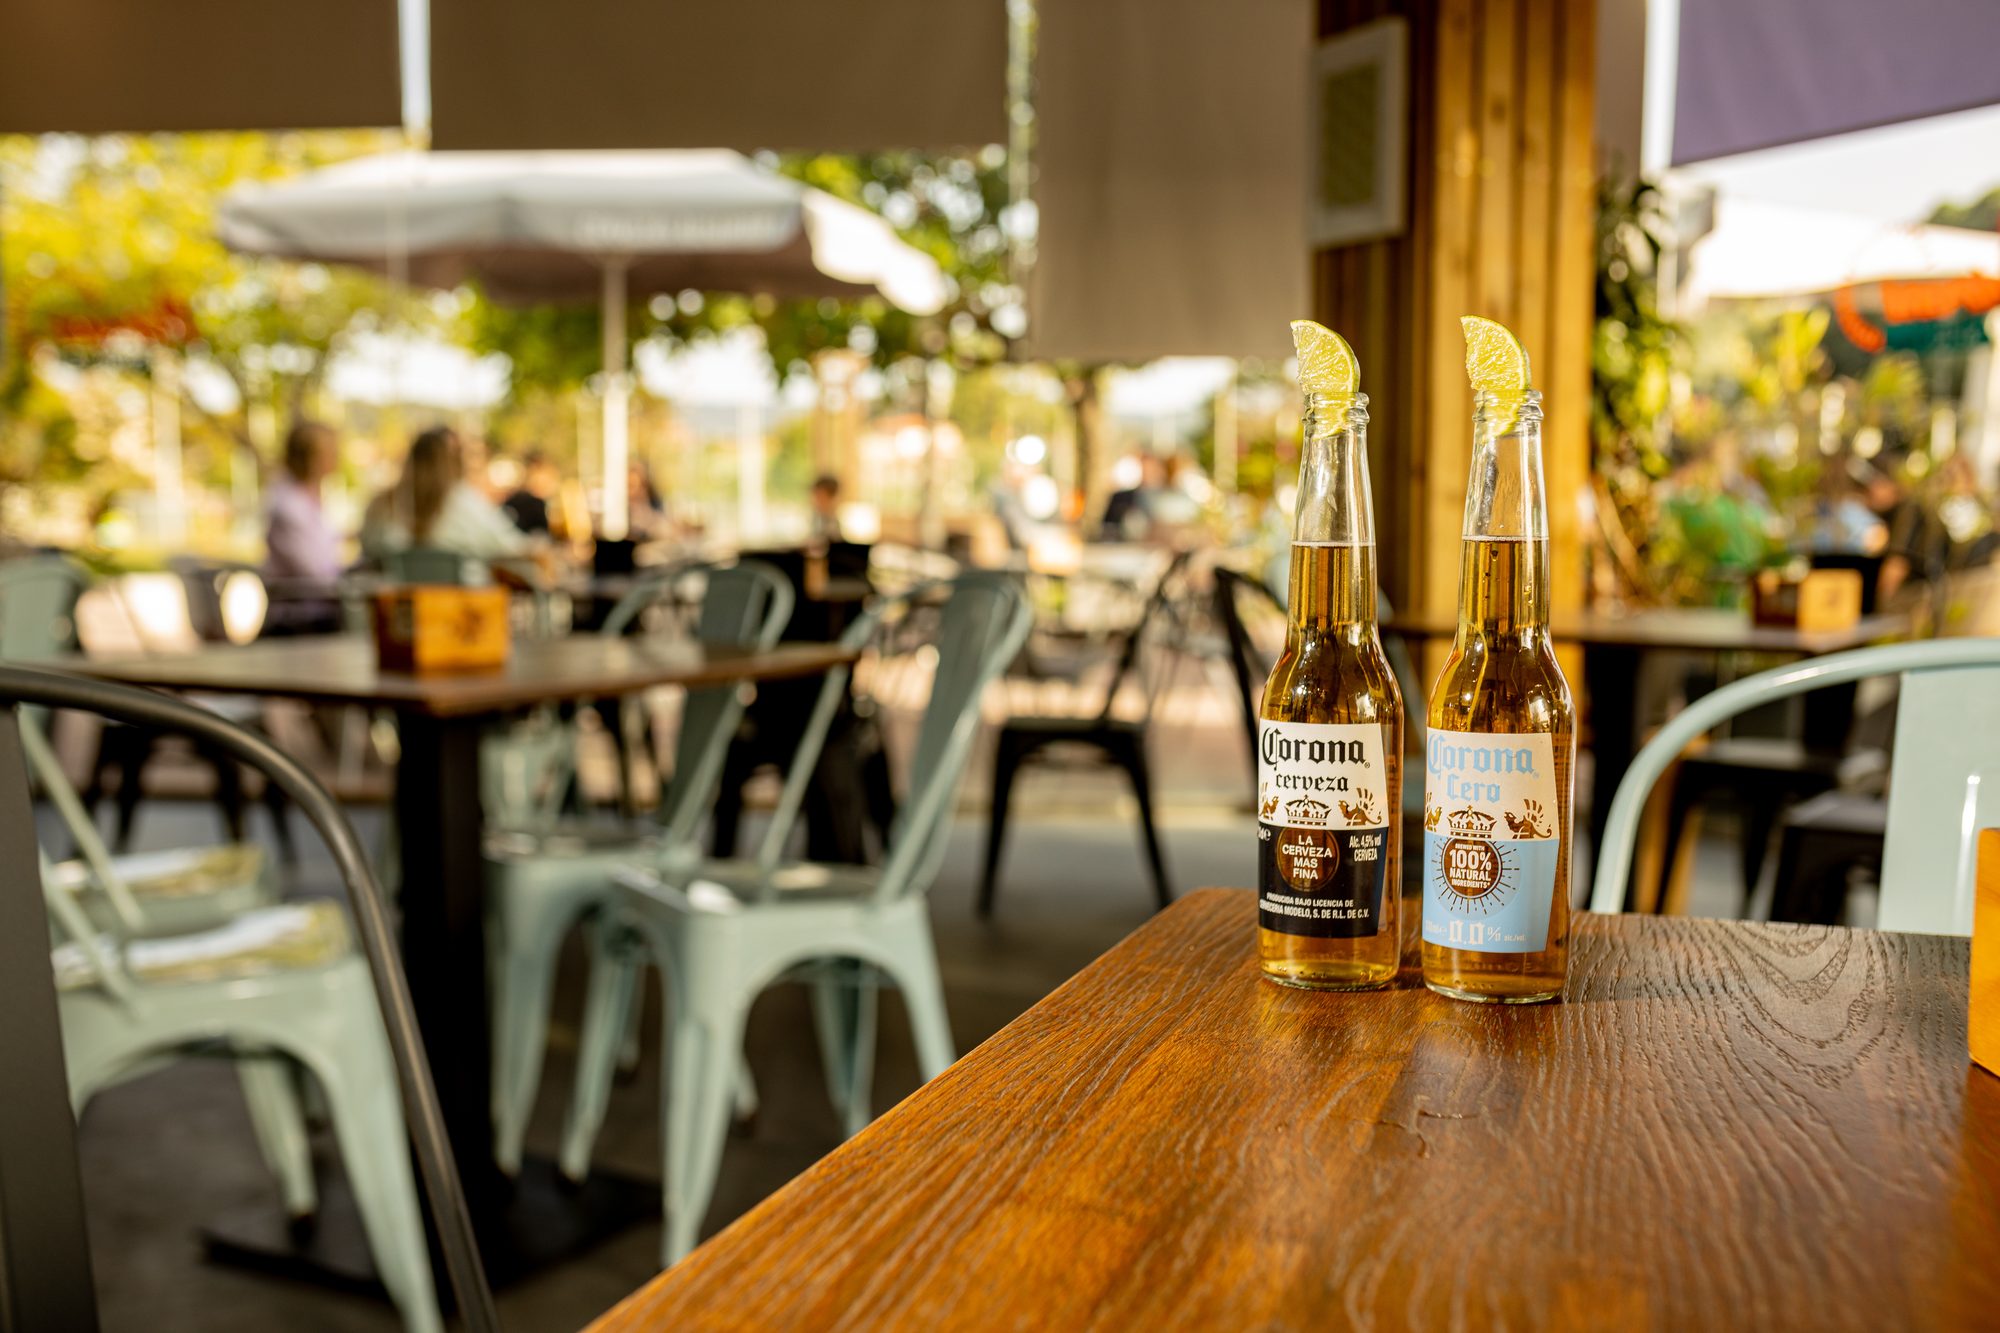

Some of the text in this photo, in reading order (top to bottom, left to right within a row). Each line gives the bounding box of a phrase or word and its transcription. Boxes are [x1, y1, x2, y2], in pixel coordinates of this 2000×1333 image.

[1262, 727, 1366, 771] Corona
[1428, 733, 1534, 779] Corona
[1447, 773, 1501, 803] Cero
[1298, 834, 1314, 846] LA
[1282, 844, 1333, 858] CERVEZA
[1354, 848, 1378, 861] CERVEZA
[1293, 856, 1318, 868] MAS
[1449, 849, 1492, 871] 100%
[1293, 868, 1318, 880] FINA
[1449, 867, 1492, 882] NATURAL
[1294, 897, 1312, 907] BAJO
[1312, 898, 1344, 908] LICENCIA
[1344, 899, 1354, 908] DE
[1321, 909, 1332, 919] DE
[1332, 909, 1347, 919] R.L.
[1346, 909, 1357, 919] DE
